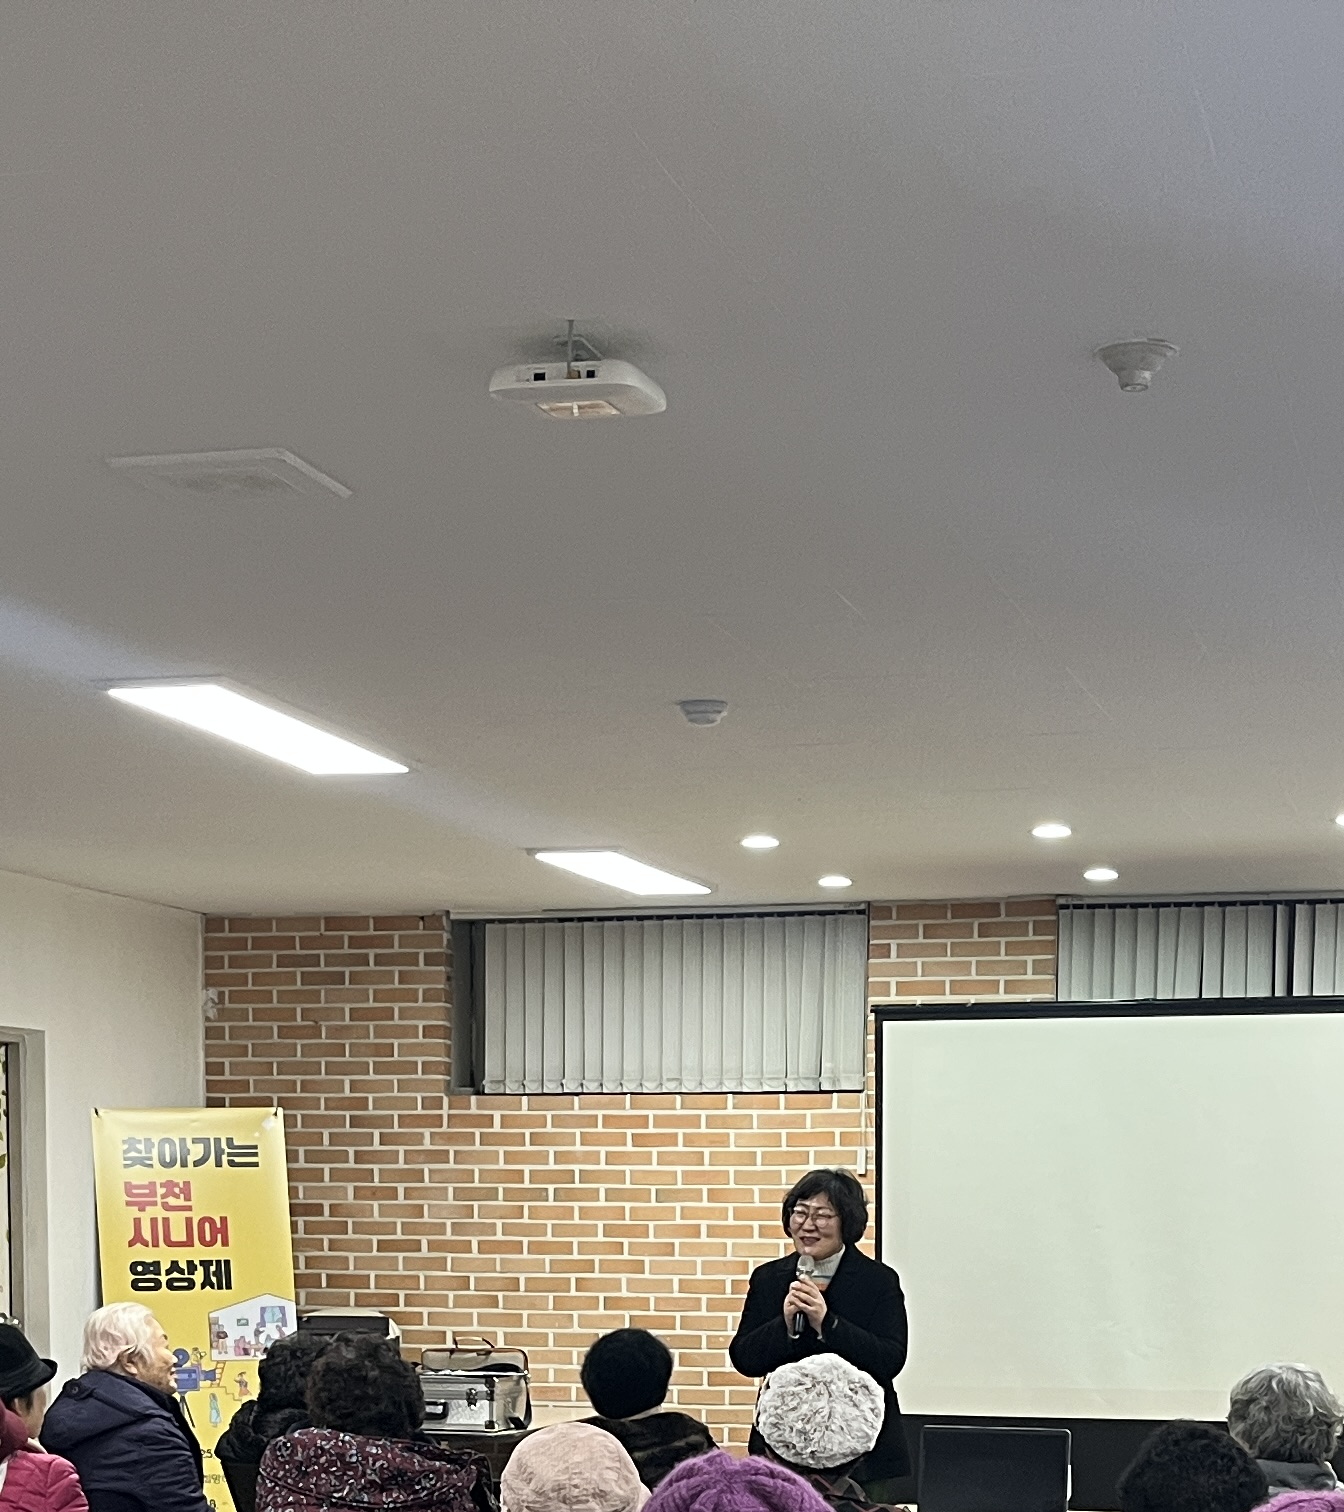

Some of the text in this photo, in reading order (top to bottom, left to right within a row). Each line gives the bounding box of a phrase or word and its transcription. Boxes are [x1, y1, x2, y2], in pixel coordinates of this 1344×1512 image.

[121, 1137, 260, 1169] 찾아가는
[124, 1179, 193, 1212] 부천
[128, 1216, 230, 1248] 시니어
[129, 1259, 233, 1292] 영상제
